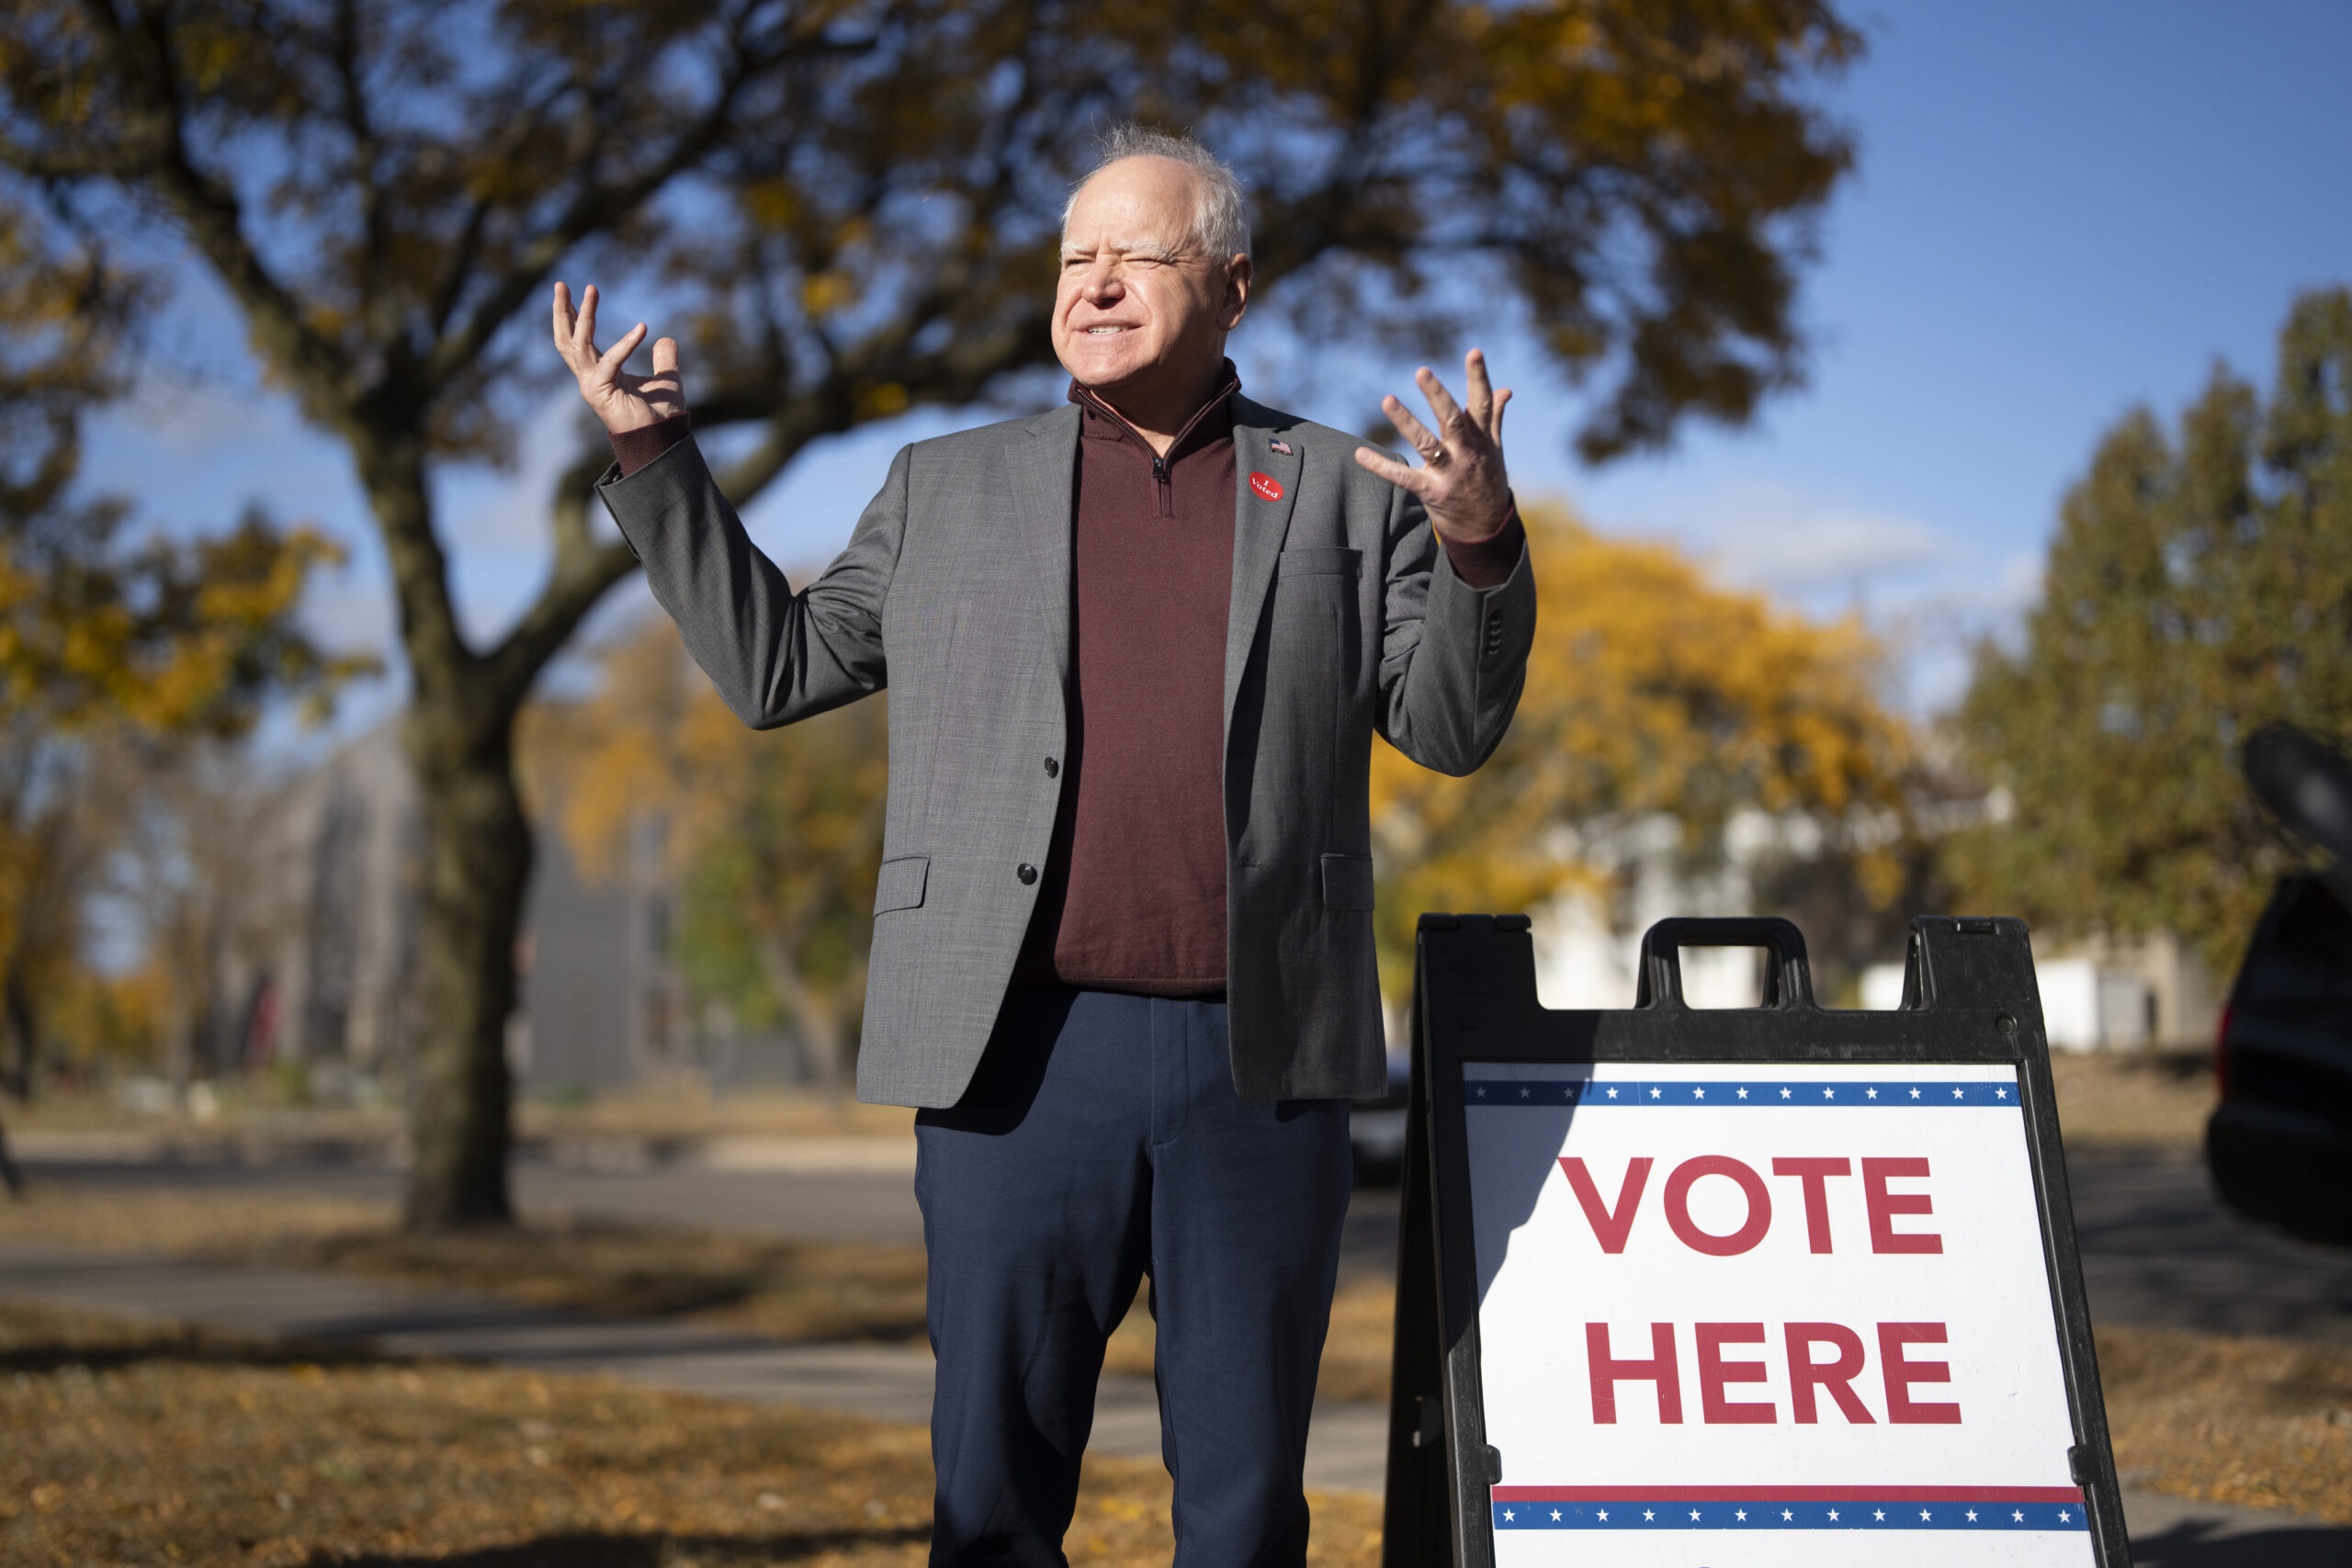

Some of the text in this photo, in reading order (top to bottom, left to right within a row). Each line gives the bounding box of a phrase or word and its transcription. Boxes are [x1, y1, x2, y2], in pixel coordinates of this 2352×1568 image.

[1251, 478, 1279, 499] Voted
[1557, 1154, 1944, 1257] VOTE
[1585, 1321, 1962, 1425] HERE
